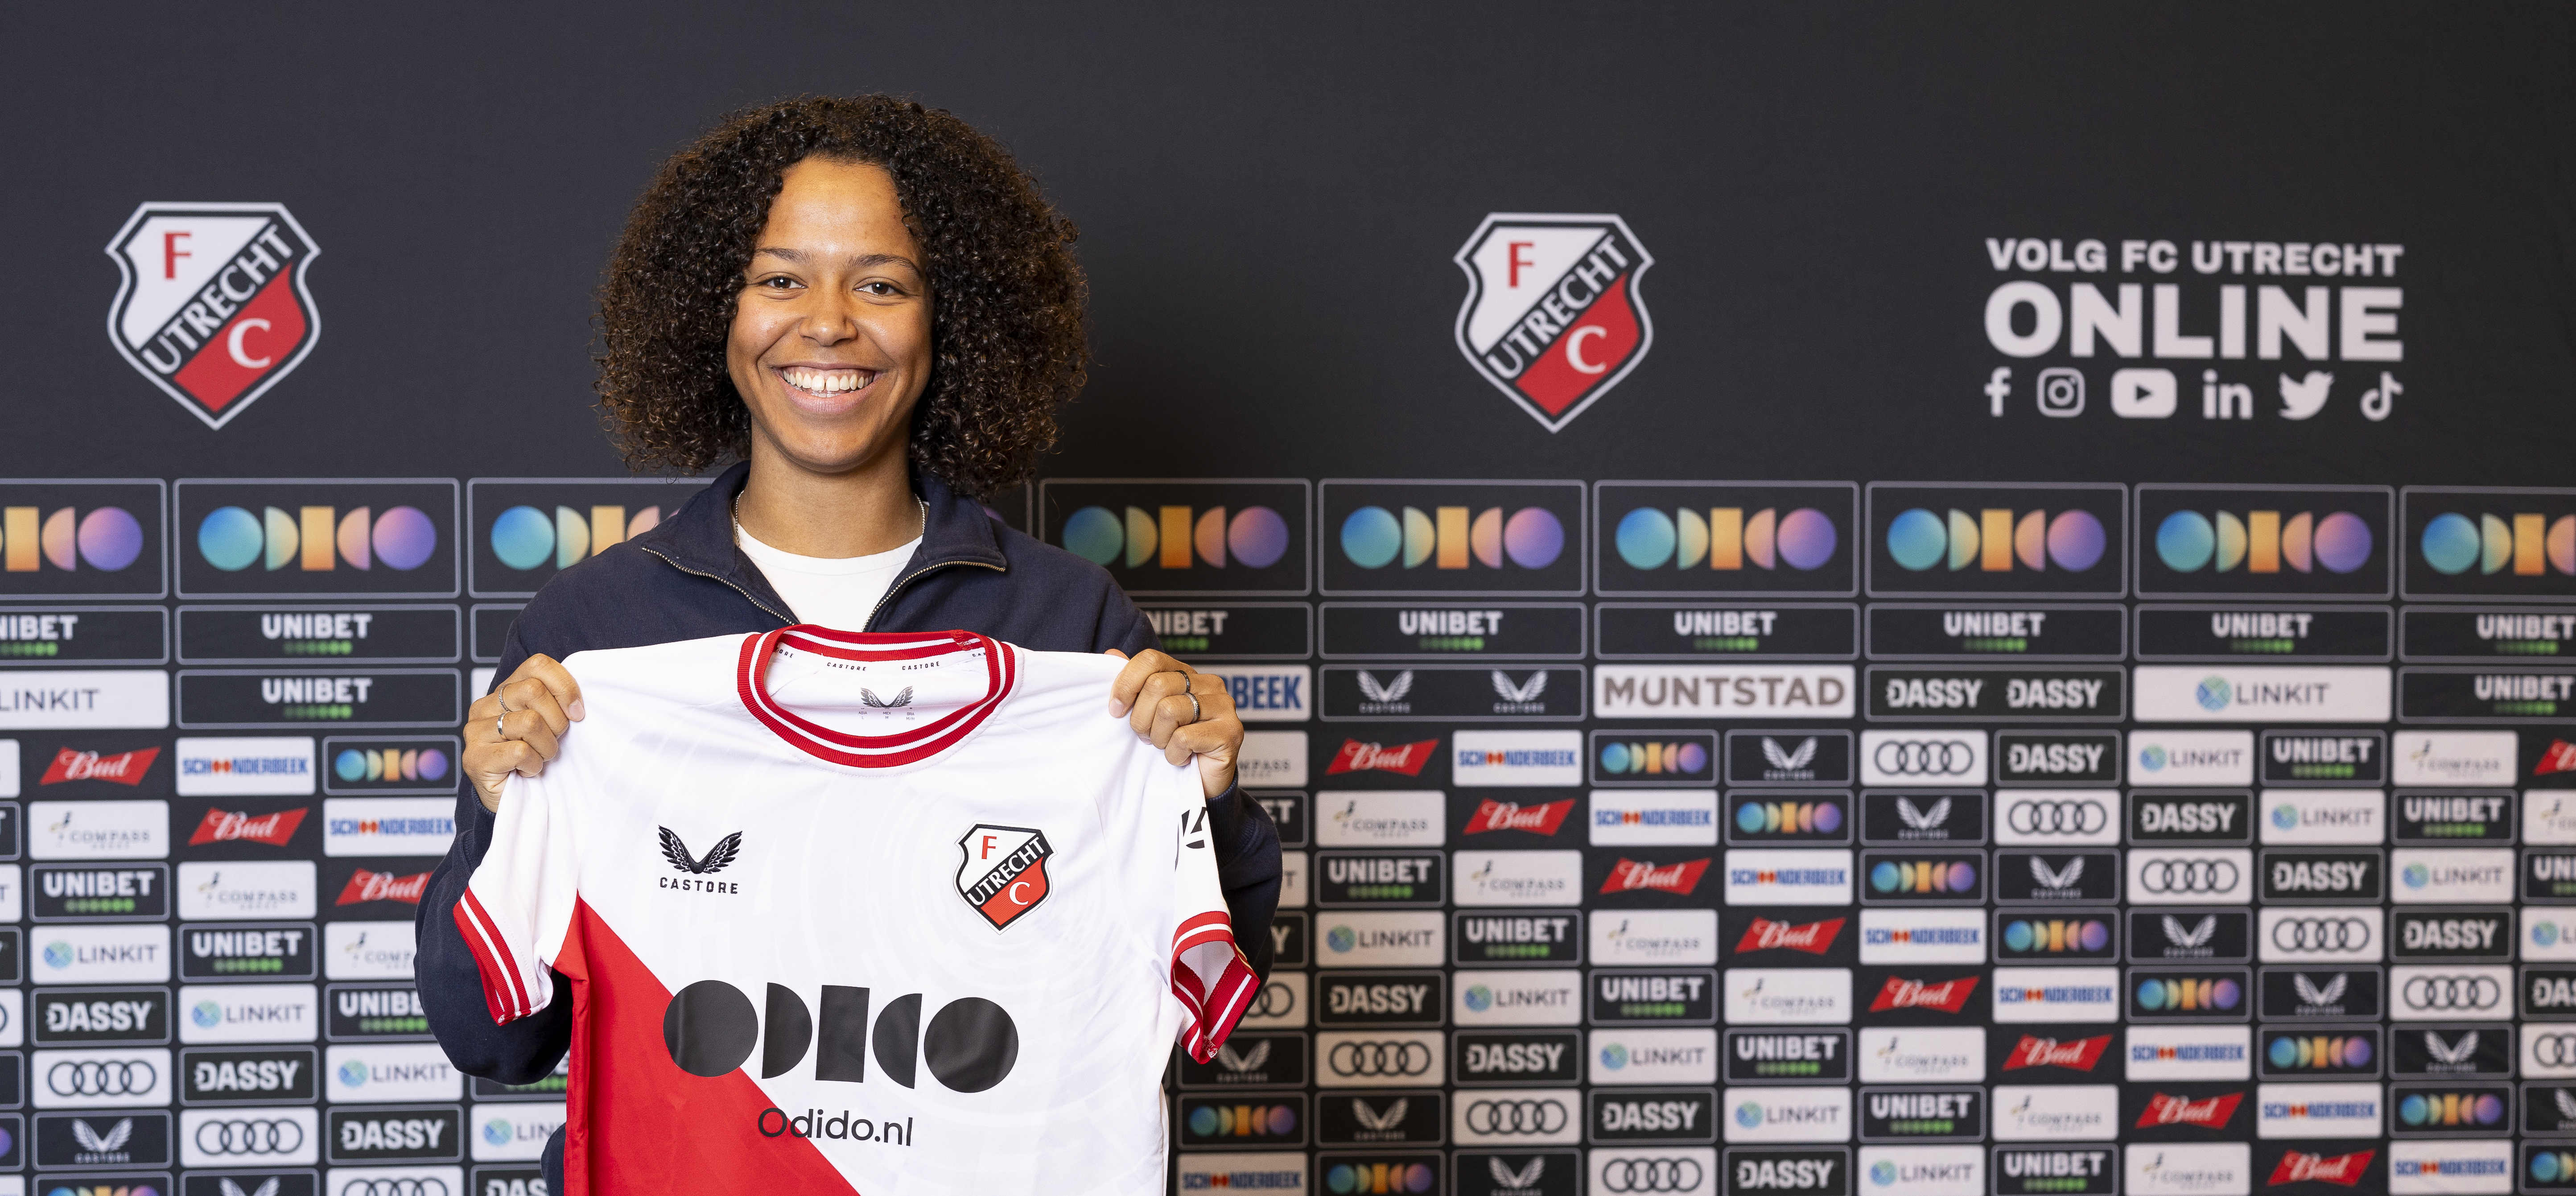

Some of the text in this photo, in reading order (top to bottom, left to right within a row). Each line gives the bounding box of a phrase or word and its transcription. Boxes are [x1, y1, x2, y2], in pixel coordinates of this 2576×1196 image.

[164, 231, 192, 280] F
[1508, 241, 1534, 288] F
[1987, 239, 2403, 276] VOLG FC UTRECHT
[141, 224, 293, 375] UTRECHT
[1486, 235, 1628, 379] UTRECHT
[1985, 281, 2402, 360] ONLINE
[228, 318, 271, 368] C
[1566, 325, 1607, 374] C
[0, 615, 77, 639] IBET
[262, 614, 371, 639] UNIBET
[1146, 610, 1229, 636] NIBET
[1400, 611, 1502, 635] UNIBET
[1675, 612, 1776, 635] UNIBET
[1945, 613, 2044, 636] UNIBET
[2213, 614, 2311, 637] UNIBET
[2477, 616, 2576, 639] UNIBET
[827, 661, 940, 671] CASTORE CASTORE
[263, 678, 371, 703] UNIBET
[1604, 676, 1845, 706] MUNTSTAD
[1887, 679, 2102, 708] DASSY DASSY
[2237, 684, 2328, 704] LINKIT
[2476, 676, 2573, 699] UNIBET
[1346, 743, 1412, 769] Bud
[2009, 744, 2103, 772] DASSY
[2170, 750, 2241, 767] LINKIT
[2274, 739, 2372, 762] UNIBET
[61, 751, 131, 779] Bud
[1483, 802, 1549, 829] Bud
[2142, 804, 2235, 831] DASSY
[2302, 808, 2372, 825] LINKIT
[2405, 798, 2503, 821] UNIBET
[210, 812, 279, 839] Bud
[982, 836, 997, 859] F
[967, 837, 1044, 905] UTRECHT
[1329, 859, 1431, 883] UNIBET
[1619, 862, 1685, 888] Bud
[2274, 862, 2366, 890] DASSY
[2432, 867, 2502, 884] LINKIT
[44, 871, 154, 897] UNIBET
[659, 876, 738, 895] CASTORE
[1009, 881, 1030, 905] C
[1358, 931, 1432, 949] LINKIT
[1467, 919, 1568, 942] UNIBET
[1754, 921, 1819, 947] Bud
[2404, 920, 2496, 948] DASSY
[78, 945, 157, 963] LINKIT
[193, 932, 302, 957] UNIBET
[364, 949, 414, 964] COMP
[1331, 985, 1427, 1013] DASSY
[1495, 990, 1568, 1007] LINKIT
[1602, 977, 1703, 1001] UNIBET
[1889, 980, 1953, 1006] Bud
[48, 1002, 151, 1031] DASSY
[226, 1005, 303, 1023] LINKIT
[338, 991, 425, 1017] UNIBE
[1467, 1044, 1563, 1072] DASSY
[1631, 1048, 1703, 1065] LINKIT
[1738, 1036, 1838, 1060] UNIBET
[2022, 1038, 2086, 1065] Bud
[196, 1061, 298, 1091] DASSY
[372, 1063, 451, 1082] LINKIT
[1603, 1102, 1698, 1130] DASSY
[1766, 1106, 1838, 1124] LINKIT
[1871, 1095, 1971, 1118] UNIBET
[342, 1120, 444, 1150] DASSY
[757, 1107, 914, 1147] Odido.nl
[1738, 1160, 1833, 1188] DASSY
[1900, 1164, 1973, 1182] LINKIT
[2005, 1152, 2104, 1176] UNIBET
